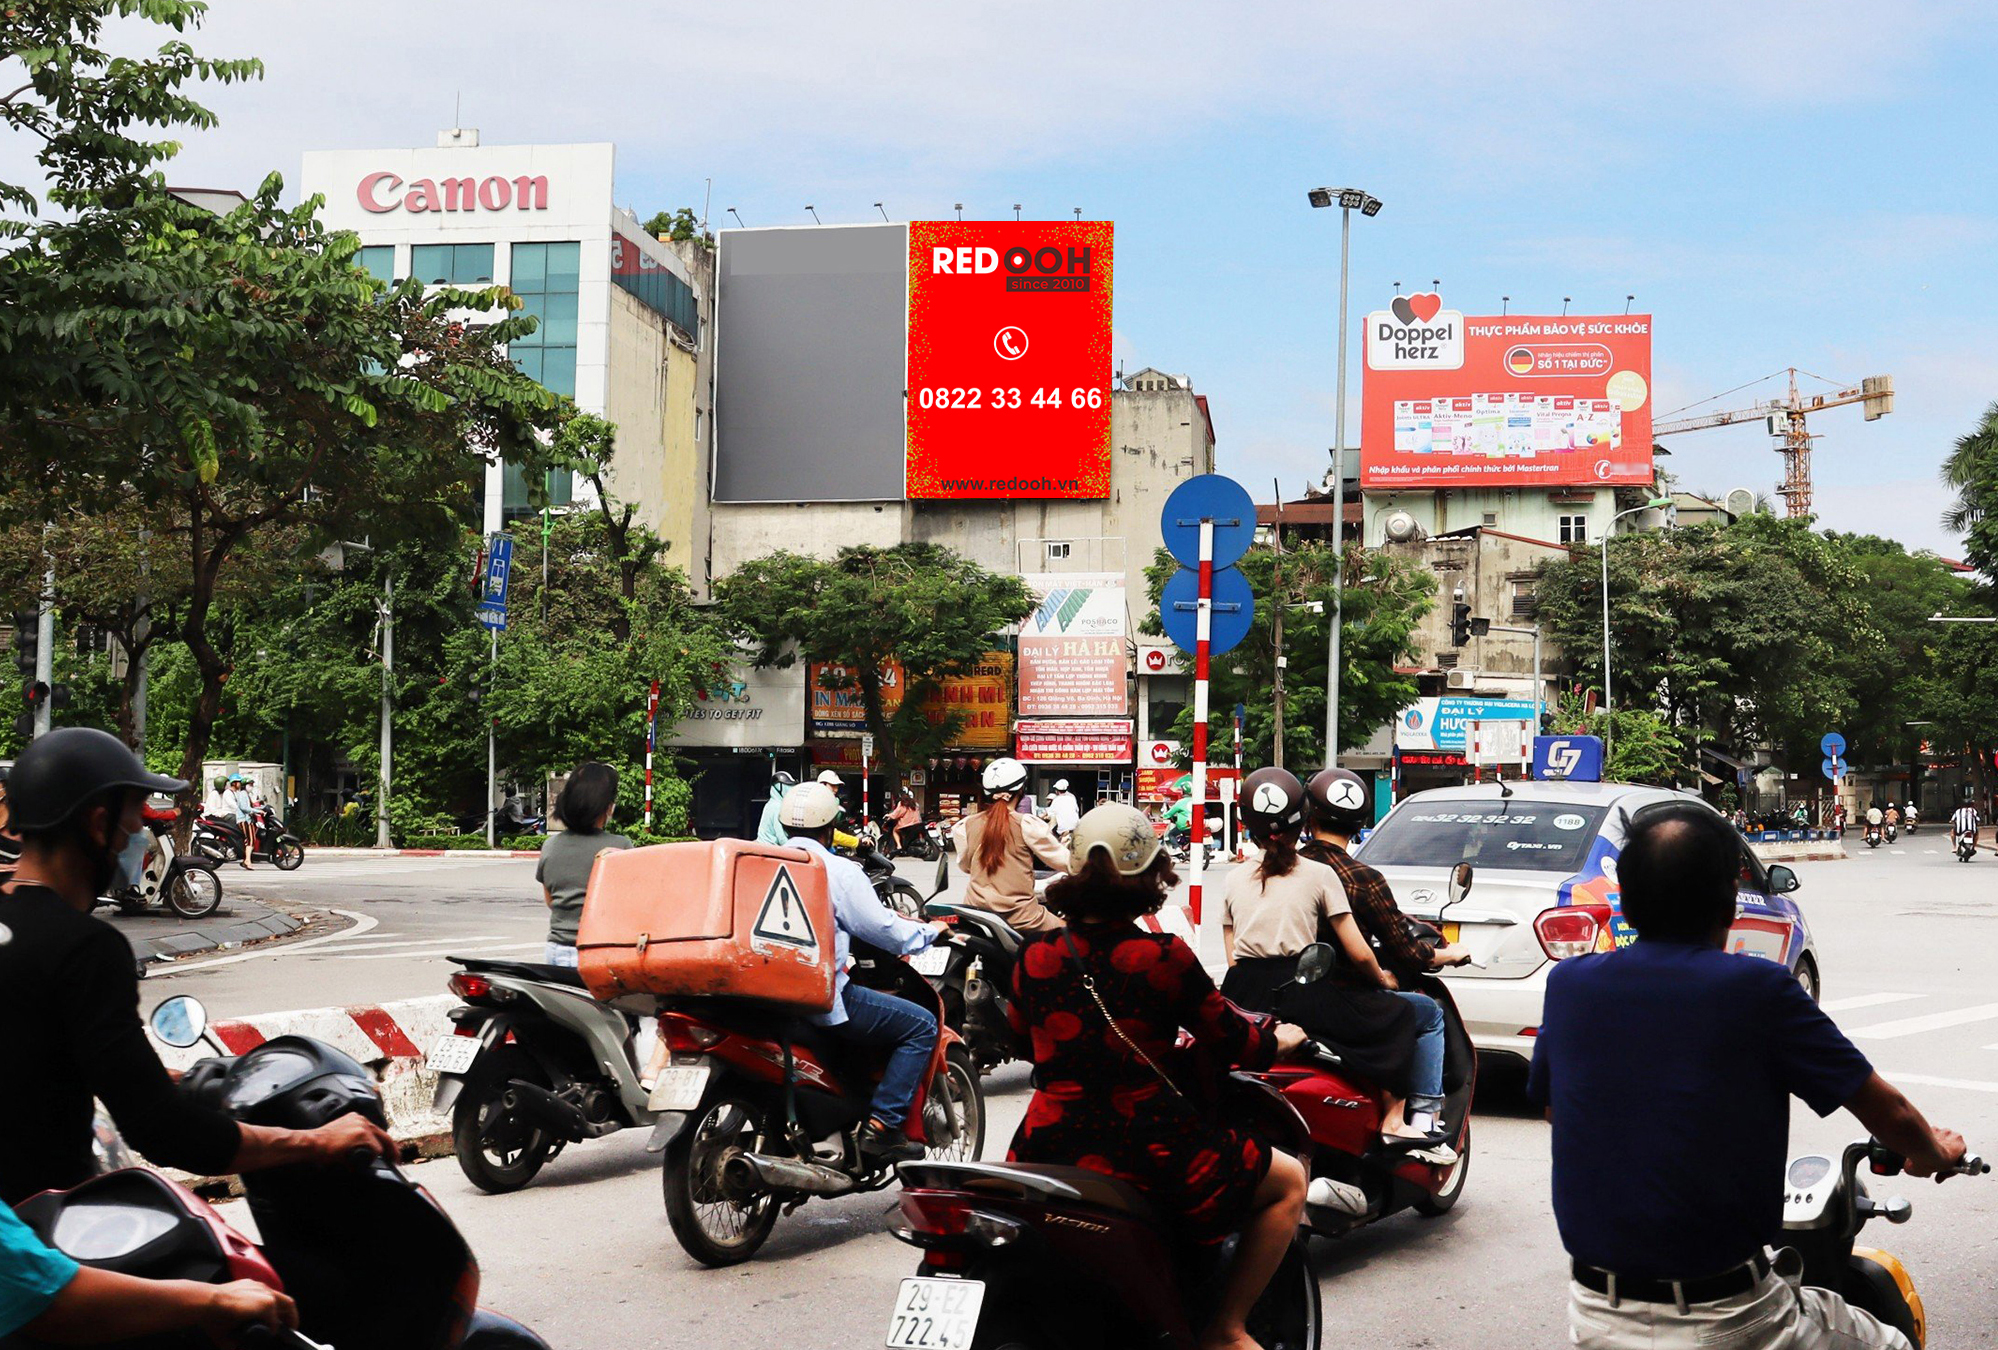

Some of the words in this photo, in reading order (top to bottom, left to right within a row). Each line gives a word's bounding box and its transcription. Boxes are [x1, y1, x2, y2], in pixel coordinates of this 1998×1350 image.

[357, 171, 548, 213] Canon
[933, 247, 999, 274] RED
[1004, 247, 1091, 274] OOH
[1011, 279, 1049, 290] since
[1052, 279, 1085, 290] 2010
[1378, 323, 1453, 345] Doppel
[1469, 325, 1503, 338] THỰC
[1505, 322, 1541, 336] PHẨM
[1543, 322, 1568, 335] BẢO
[1570, 322, 1586, 336] VỆ
[1588, 321, 1612, 334] SỨC
[1614, 321, 1648, 334] KHỎE
[1394, 342, 1439, 359] herz
[1537, 358, 1552, 369] SỐ
[1554, 360, 1560, 368] 1
[1561, 359, 1578, 370] TẠI
[919, 387, 982, 409] 0822
[991, 387, 1022, 409] 33
[1030, 387, 1062, 409] 44
[1071, 387, 1102, 409] 66
[1369, 465, 1390, 476] Nhập
[1391, 464, 1410, 474] khẩu
[1411, 465, 1420, 473] và
[1421, 465, 1442, 475] phân
[1443, 463, 1460, 475] phối
[1461, 463, 1482, 473] chính
[1483, 463, 1501, 472] thức
[1502, 463, 1515, 472] bởi
[1516, 463, 1559, 472] Mastertran
[941, 476, 1079, 491] www.redooh.vn
[1023, 647, 1042, 659] ĐẠI
[1045, 645, 1060, 656] LÝ
[1063, 638, 1090, 656] HÀ
[1094, 638, 1122, 656] HÀ
[814, 690, 831, 708] IN
[708, 708, 722, 719] TO
[724, 708, 744, 719] GET
[745, 708, 763, 719] FIT
[1440, 707, 1464, 716] ĐẠI
[1467, 706, 1485, 715] LÝ
[1547, 740, 1582, 777] G7
[1456, 814, 1483, 824] 32
[1482, 815, 1509, 825] 32
[1509, 815, 1537, 825] 32
[1557, 818, 1581, 826] 1188
[1044, 1212, 1112, 1234] VISION
[906, 1283, 969, 1315] 29-E2
[892, 1315, 970, 1348] 722.45
